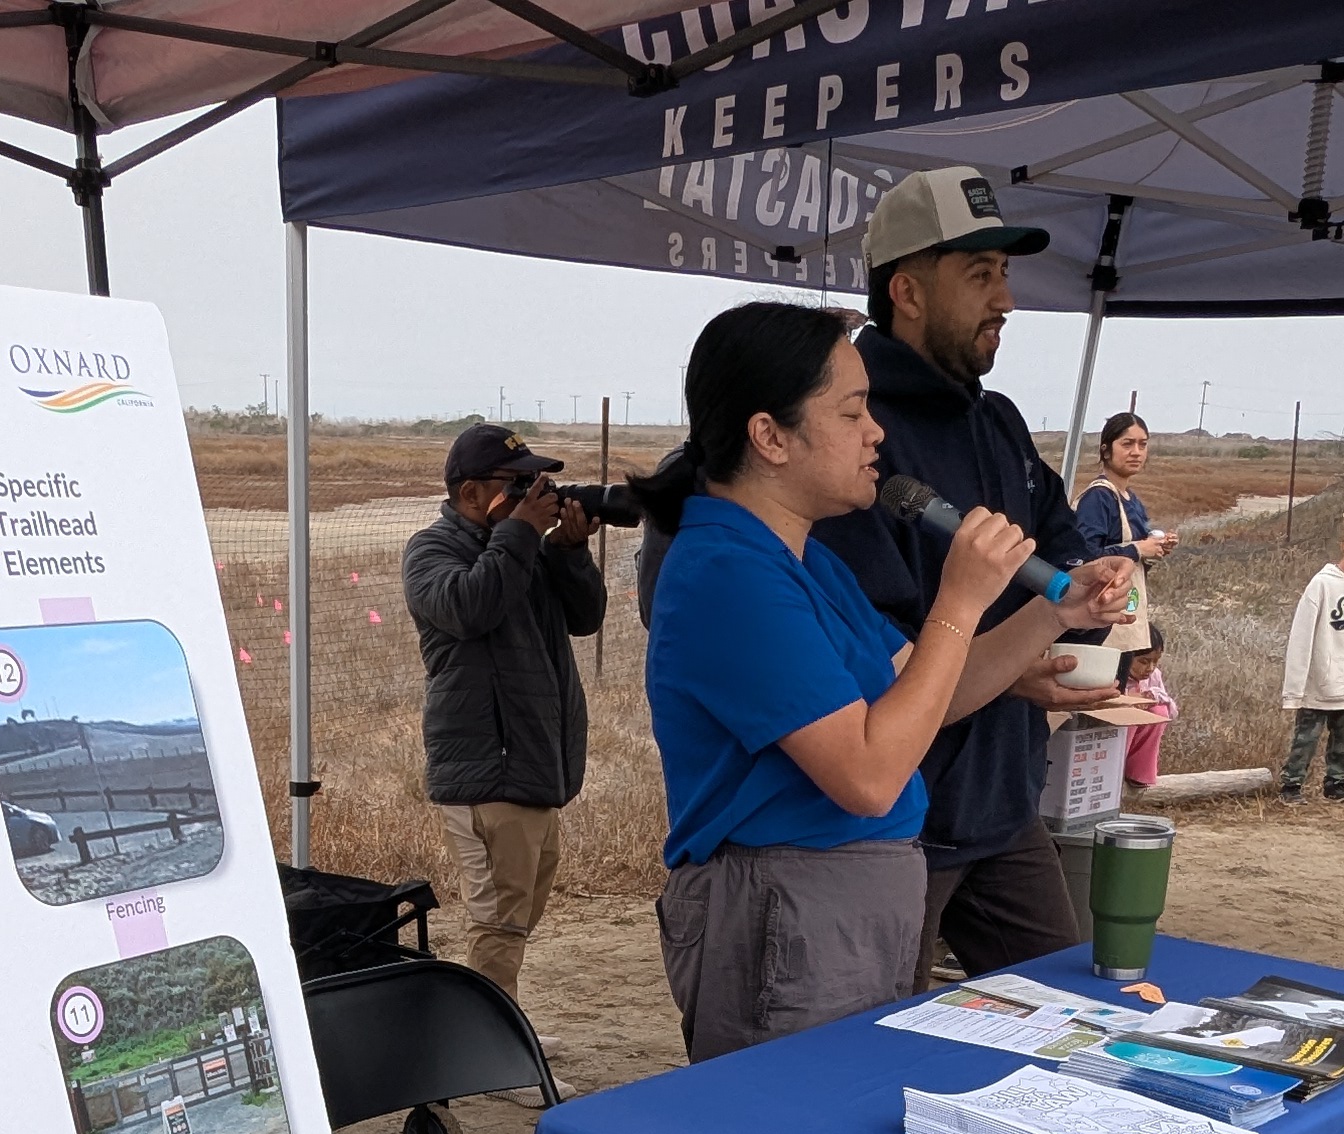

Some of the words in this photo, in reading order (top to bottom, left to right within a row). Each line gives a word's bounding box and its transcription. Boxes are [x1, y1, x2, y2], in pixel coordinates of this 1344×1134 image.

[663, 42, 1029, 158] KEEPERS
[10, 345, 130, 381] OXNARD
[3, 550, 105, 575] Elements
[106, 894, 166, 921] Fencing
[69, 1004, 91, 1026] 11
